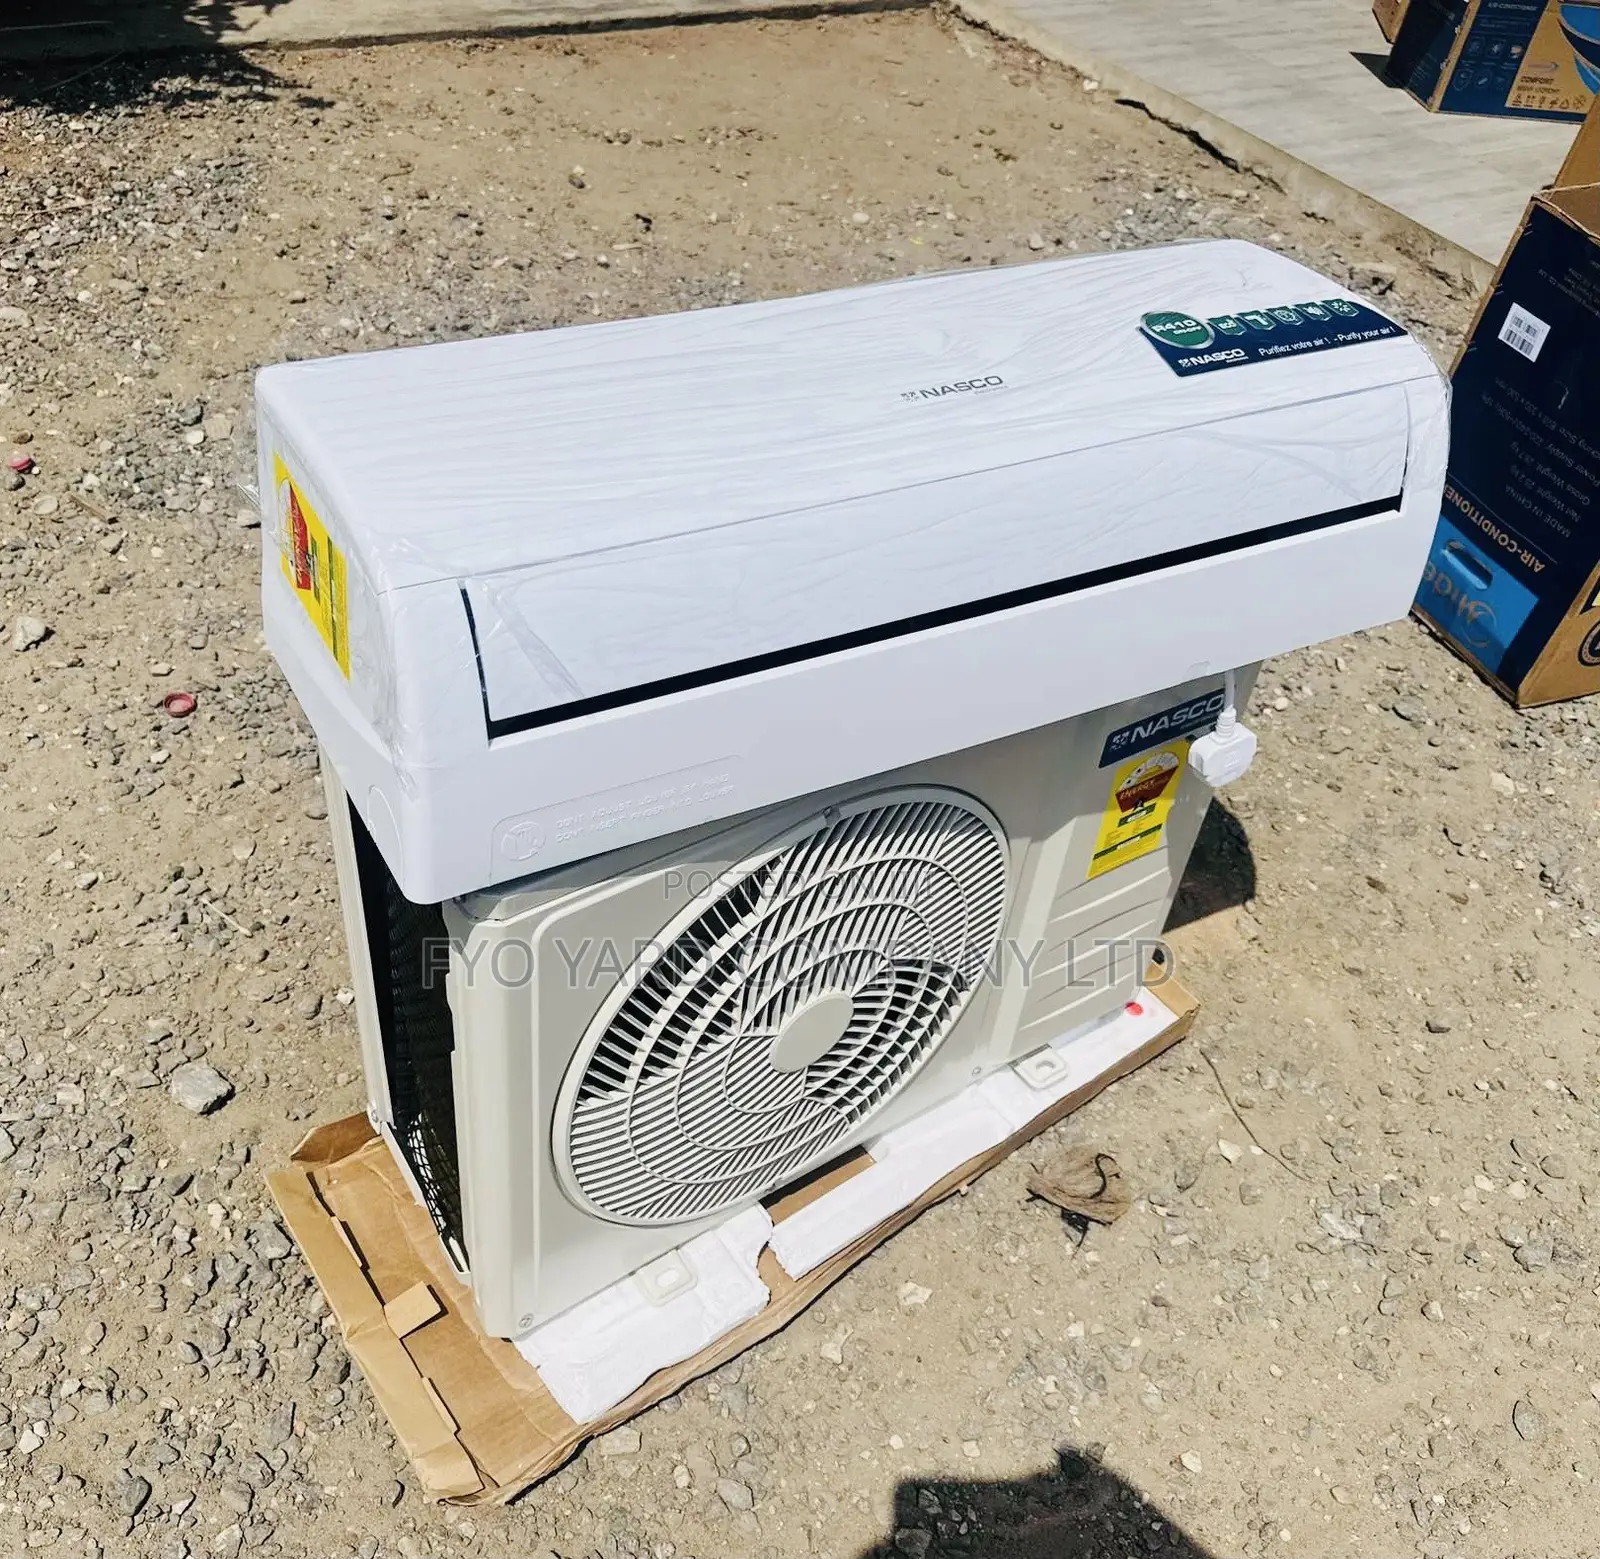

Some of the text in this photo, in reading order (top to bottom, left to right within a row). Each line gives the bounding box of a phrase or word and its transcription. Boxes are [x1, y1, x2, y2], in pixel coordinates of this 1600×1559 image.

[1188, 348, 1245, 366] NASCO
[1258, 345, 1291, 356] Purifiez
[1291, 340, 1313, 351] votre
[1313, 337, 1324, 346] air
[1337, 331, 1361, 342] Purify
[1361, 327, 1379, 339] your
[1380, 327, 1390, 335] air
[919, 375, 1003, 398] NASCO
[1444, 482, 1546, 574] AIR-CONDITIONE
[1505, 484, 1572, 538] MADE IN CHINA
[1131, 693, 1225, 744] NASCO
